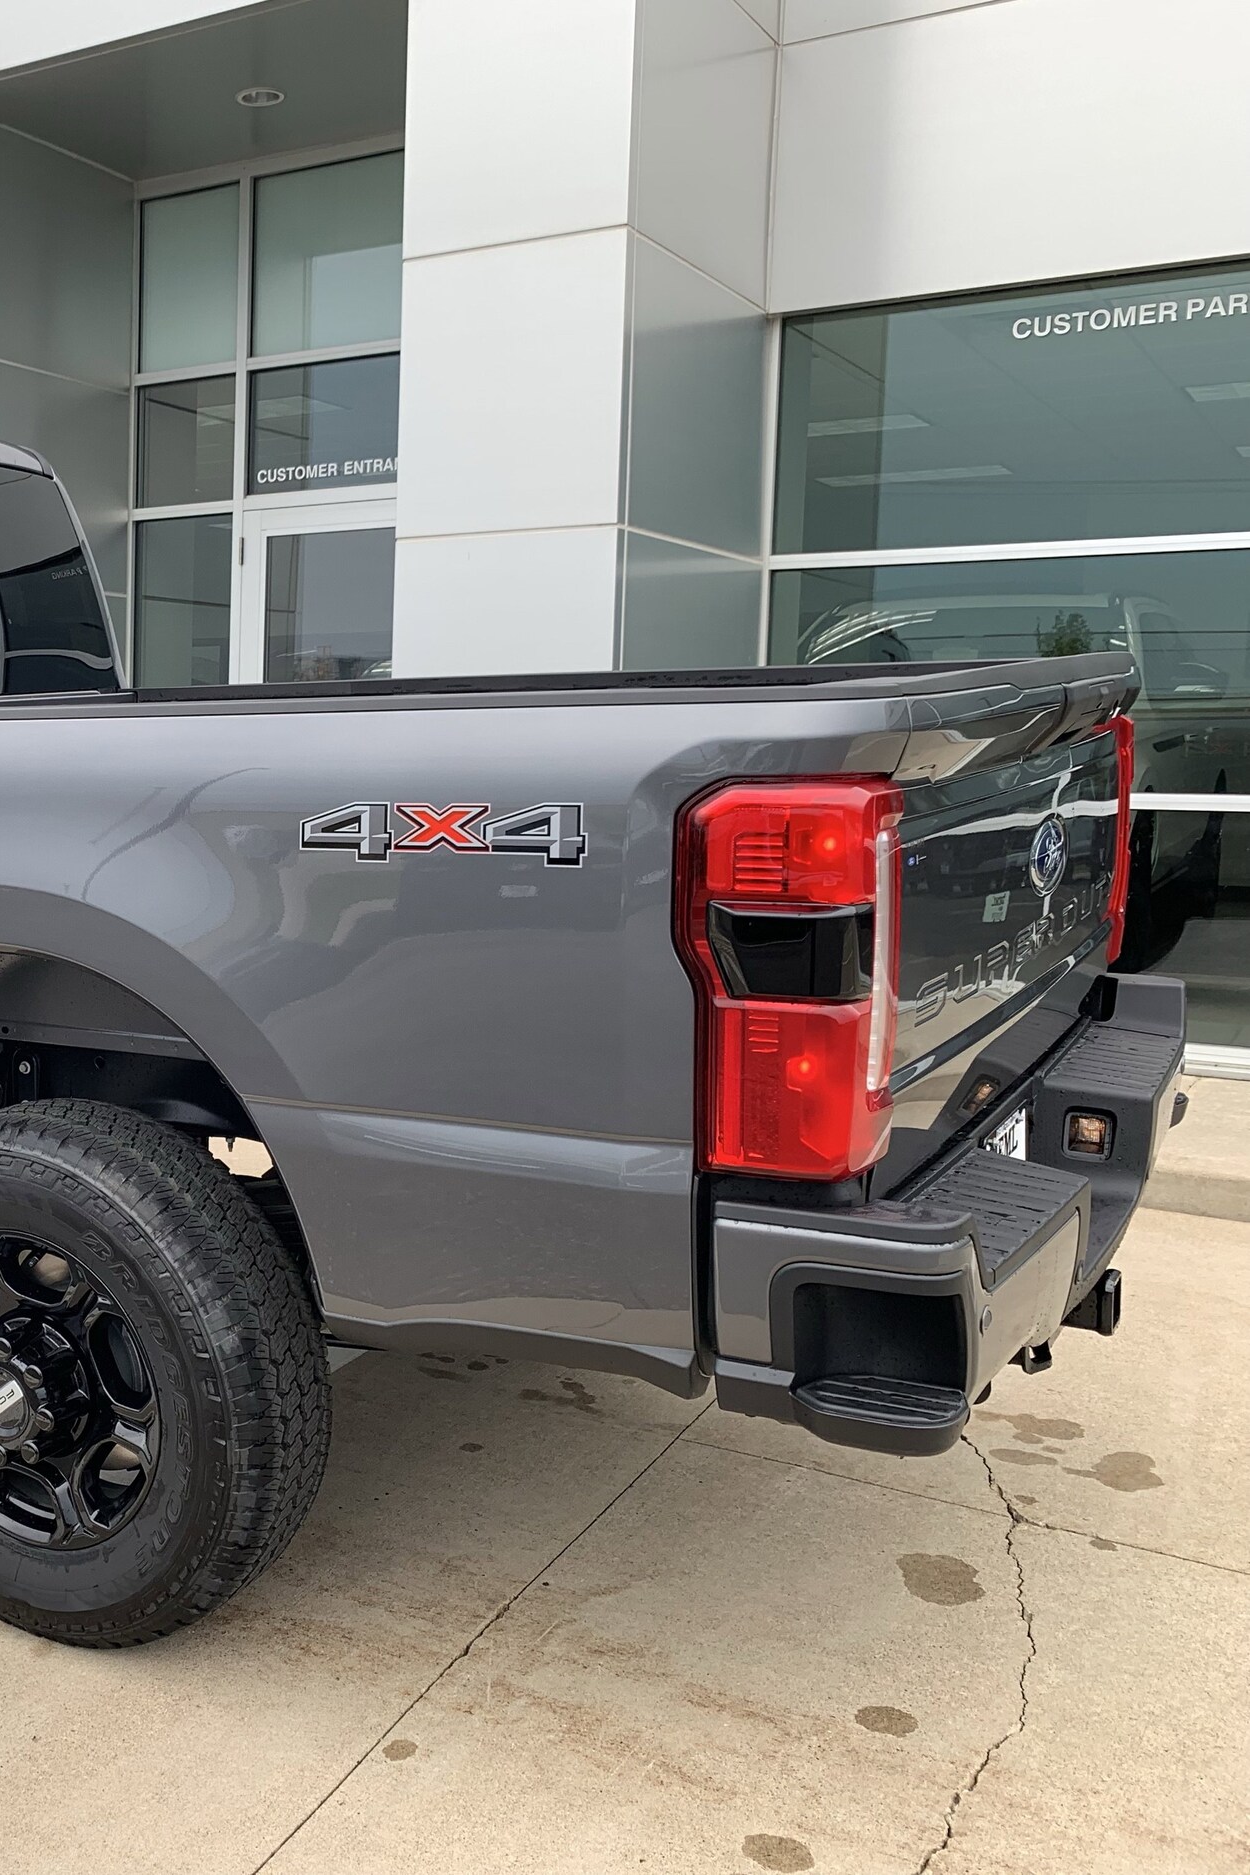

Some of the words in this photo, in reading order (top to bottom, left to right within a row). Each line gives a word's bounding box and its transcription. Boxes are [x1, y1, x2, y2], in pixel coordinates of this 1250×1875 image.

[1012, 301, 1177, 339] CUSTOMER
[257, 463, 338, 484] CUSTOMER
[914, 912, 1055, 1028] SUPER
[77, 1230, 194, 1578] BRIDGESTONE
